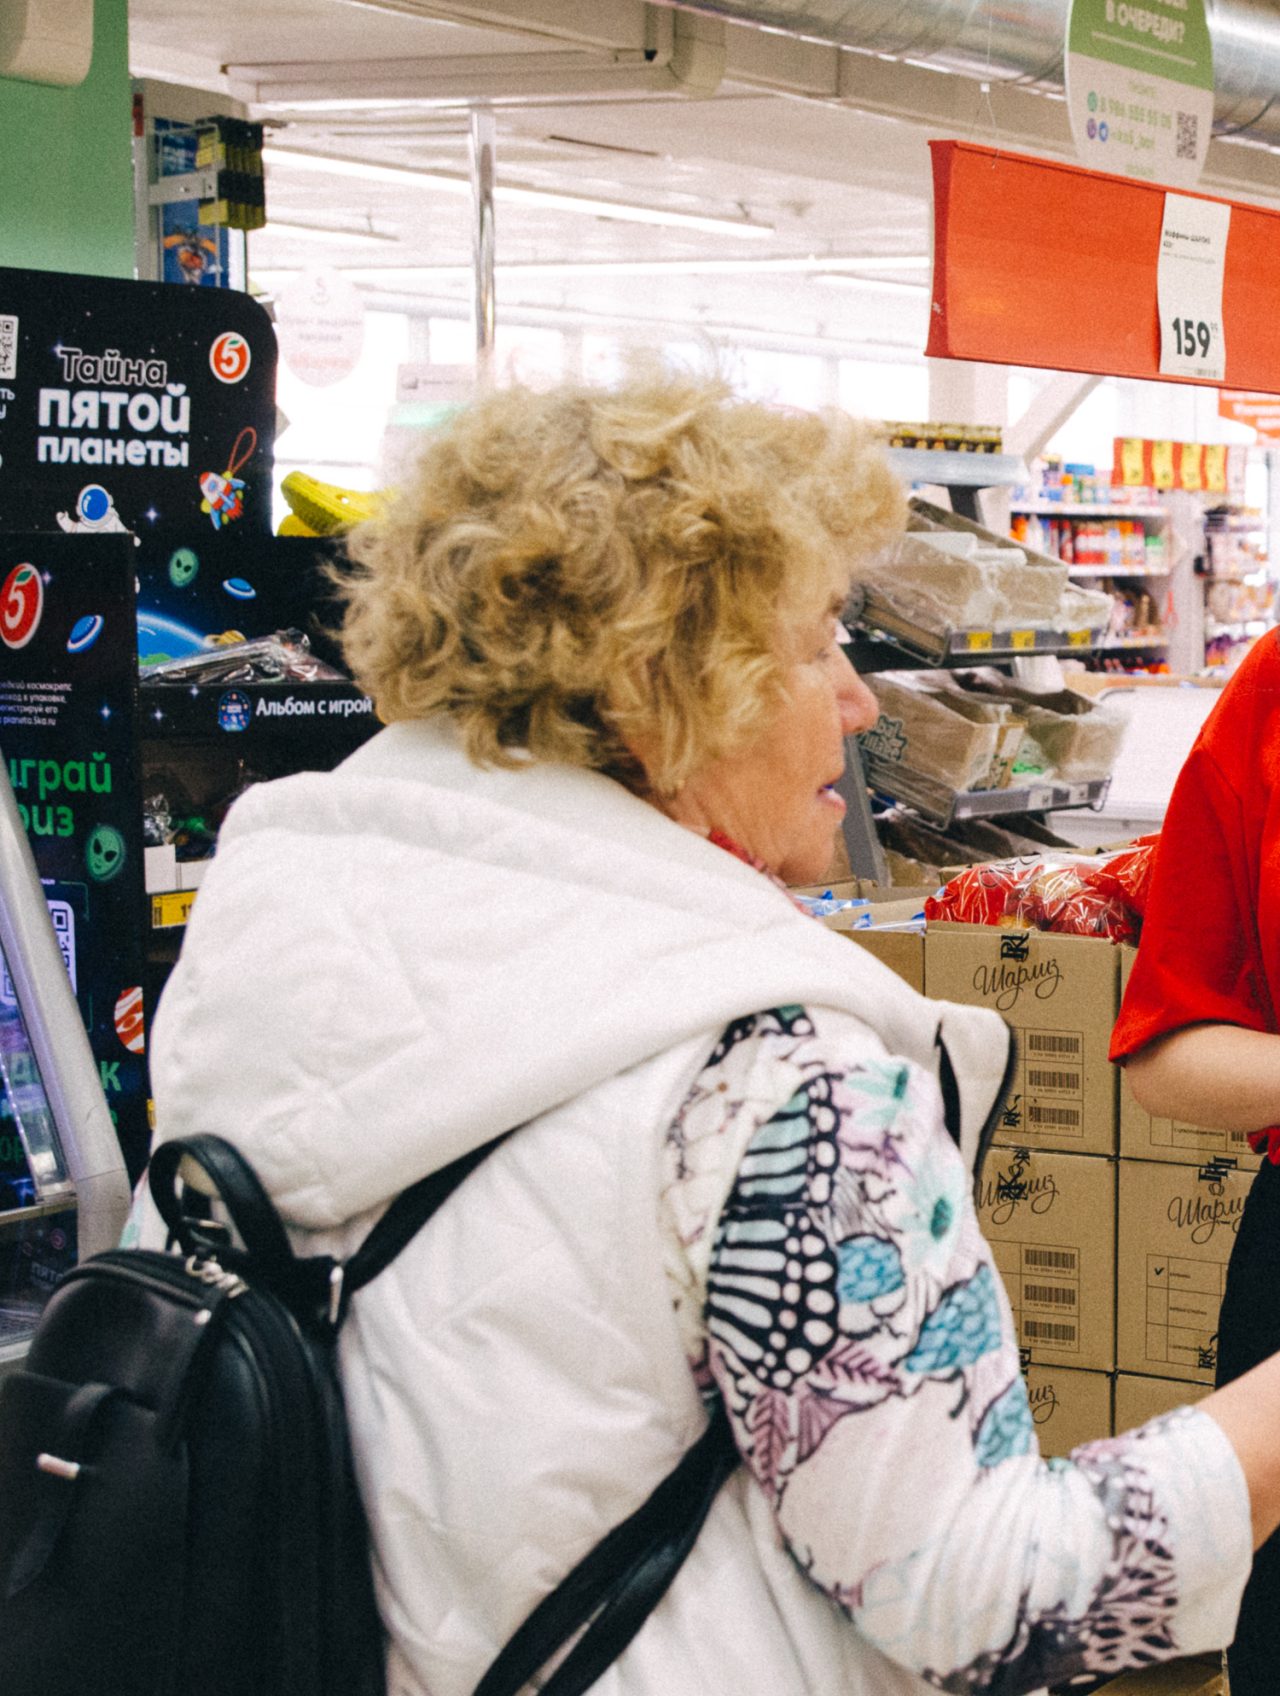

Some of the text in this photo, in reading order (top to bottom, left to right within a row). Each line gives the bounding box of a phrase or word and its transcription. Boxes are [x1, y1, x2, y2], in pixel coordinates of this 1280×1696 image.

[1172, 317, 1211, 358] 159
[59, 346, 168, 387] Тайна
[37, 436, 190, 467] планеты
[256, 696, 373, 717] Альбом с игрой
